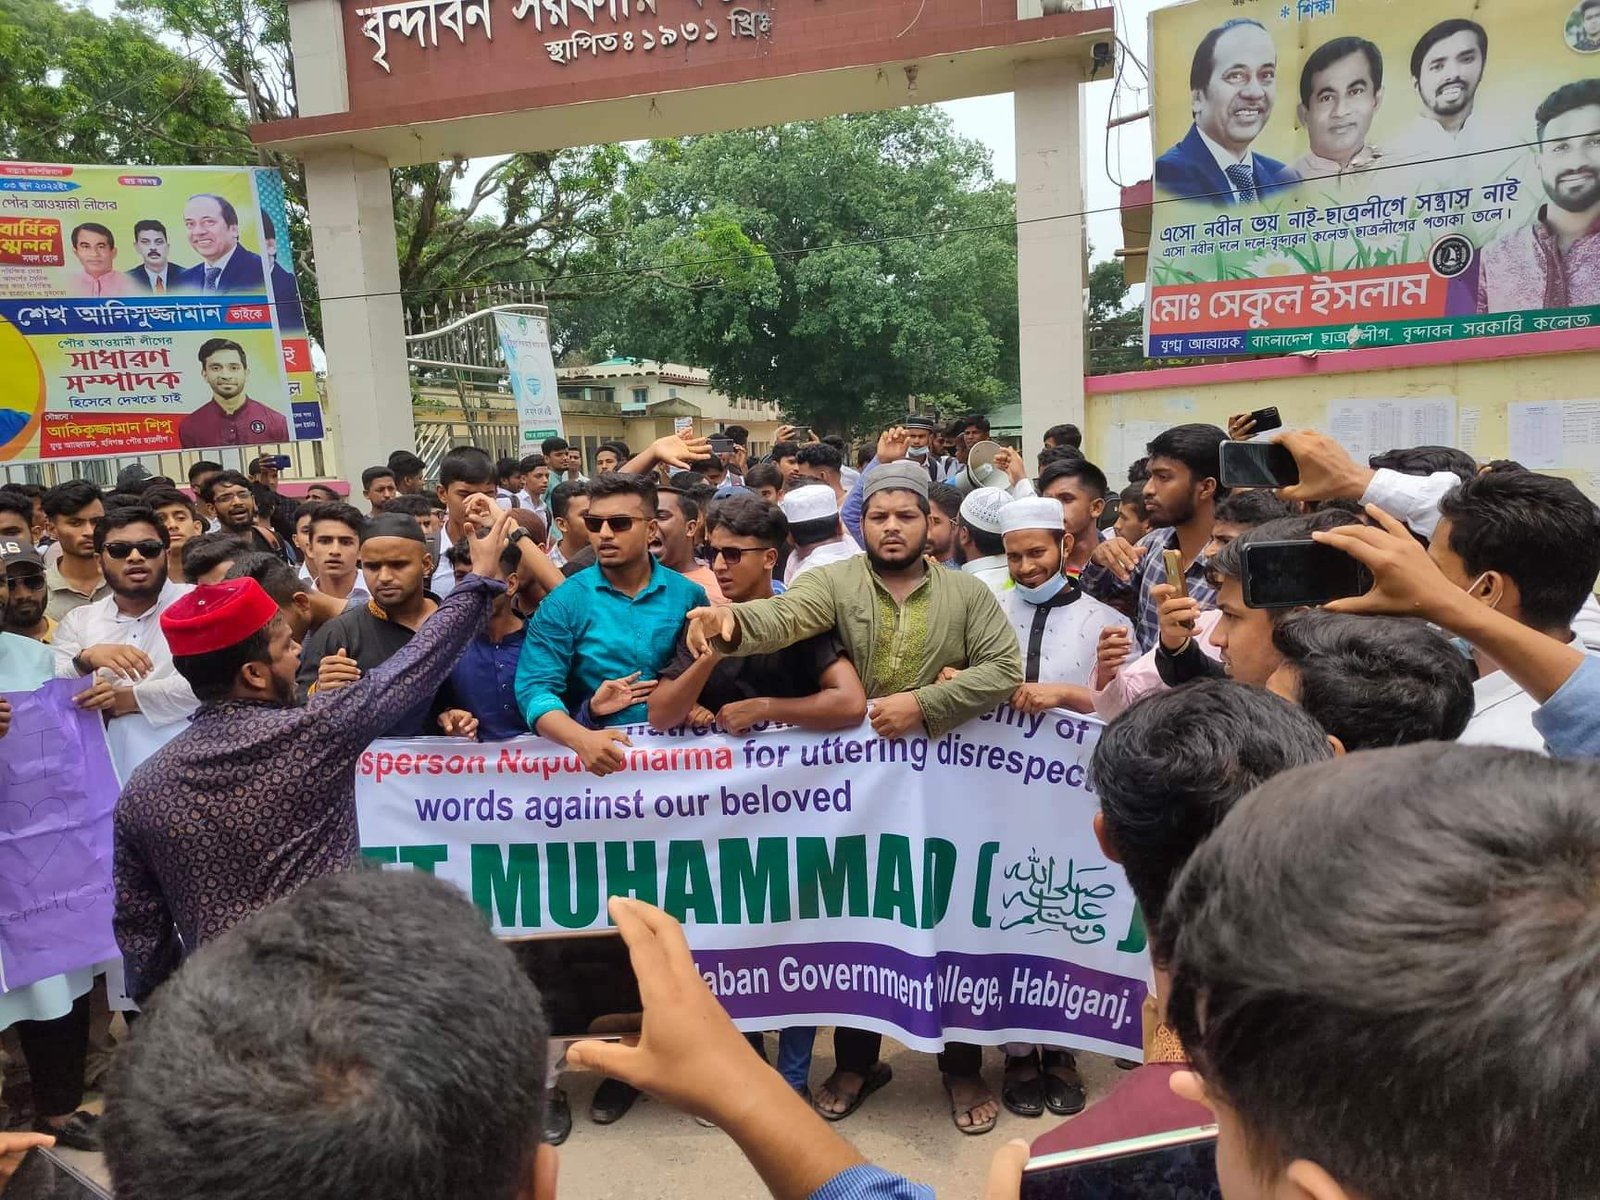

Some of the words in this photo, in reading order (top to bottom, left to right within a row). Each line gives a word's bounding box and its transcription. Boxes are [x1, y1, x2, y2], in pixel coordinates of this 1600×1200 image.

[356, 0, 494, 73] বৃন্দাবন
[641, 18, 719, 50] ১৯৩১
[18, 181, 32, 190] জুন
[2, 194, 28, 209] পৌর
[32, 197, 80, 210] আওয়ামী
[83, 197, 117, 211] লীগের
[1159, 224, 1195, 244] এসো
[1204, 215, 1243, 238] নবীন
[1250, 214, 1280, 232] ভয়
[1288, 195, 1408, 230] নাই-ছাত্রলীগে
[1415, 187, 1473, 214] সন্ত্রাস
[1481, 177, 1521, 204] নাই
[1162, 243, 1185, 258] এসো
[1190, 240, 1214, 256] নবীন
[1219, 240, 1239, 252] দলে
[1312, 228, 1349, 243] কলেজ
[1355, 218, 1417, 239] ছাত্রলীগের
[1423, 213, 1466, 230] পতাকা
[18, 305, 69, 326] শেখ
[74, 299, 222, 329] আনিসুজ্জামান
[232, 308, 264, 322] ভাইকে
[1151, 293, 1201, 322] মোঃ
[1209, 285, 1305, 328] সেকুল
[1310, 273, 1430, 316] ইসলাম
[58, 337, 84, 349] পৌর
[88, 336, 135, 348] আওয়ামী
[139, 335, 173, 346] লীগের
[1160, 339, 1184, 354] যুগ্ম
[1252, 332, 1313, 348] বাংলাদেশ
[1402, 324, 1454, 344] বৃন্দাবন
[1462, 314, 1525, 336] সরকারি
[1532, 312, 1593, 330] কলেজ
[65, 348, 170, 370] সাধারণ
[60, 371, 183, 393] সম্পাদক
[68, 395, 112, 409] হিসেবে
[118, 394, 157, 407] দেখতে
[162, 392, 183, 404] চাই
[143, 417, 174, 435] শিপু
[1055, 718, 1090, 745] of
[357, 751, 485, 783] sperson
[497, 748, 591, 780] Nupu
[743, 739, 790, 768] for
[801, 732, 928, 771] uttering
[937, 732, 1093, 792] disrespec
[415, 789, 514, 821] words
[525, 788, 644, 828] against
[654, 793, 709, 818] our
[720, 779, 853, 817] beloved
[470, 833, 958, 930] MUHAMMAD
[778, 956, 934, 1012] Government
[1010, 967, 1133, 1030] Habiganj.
